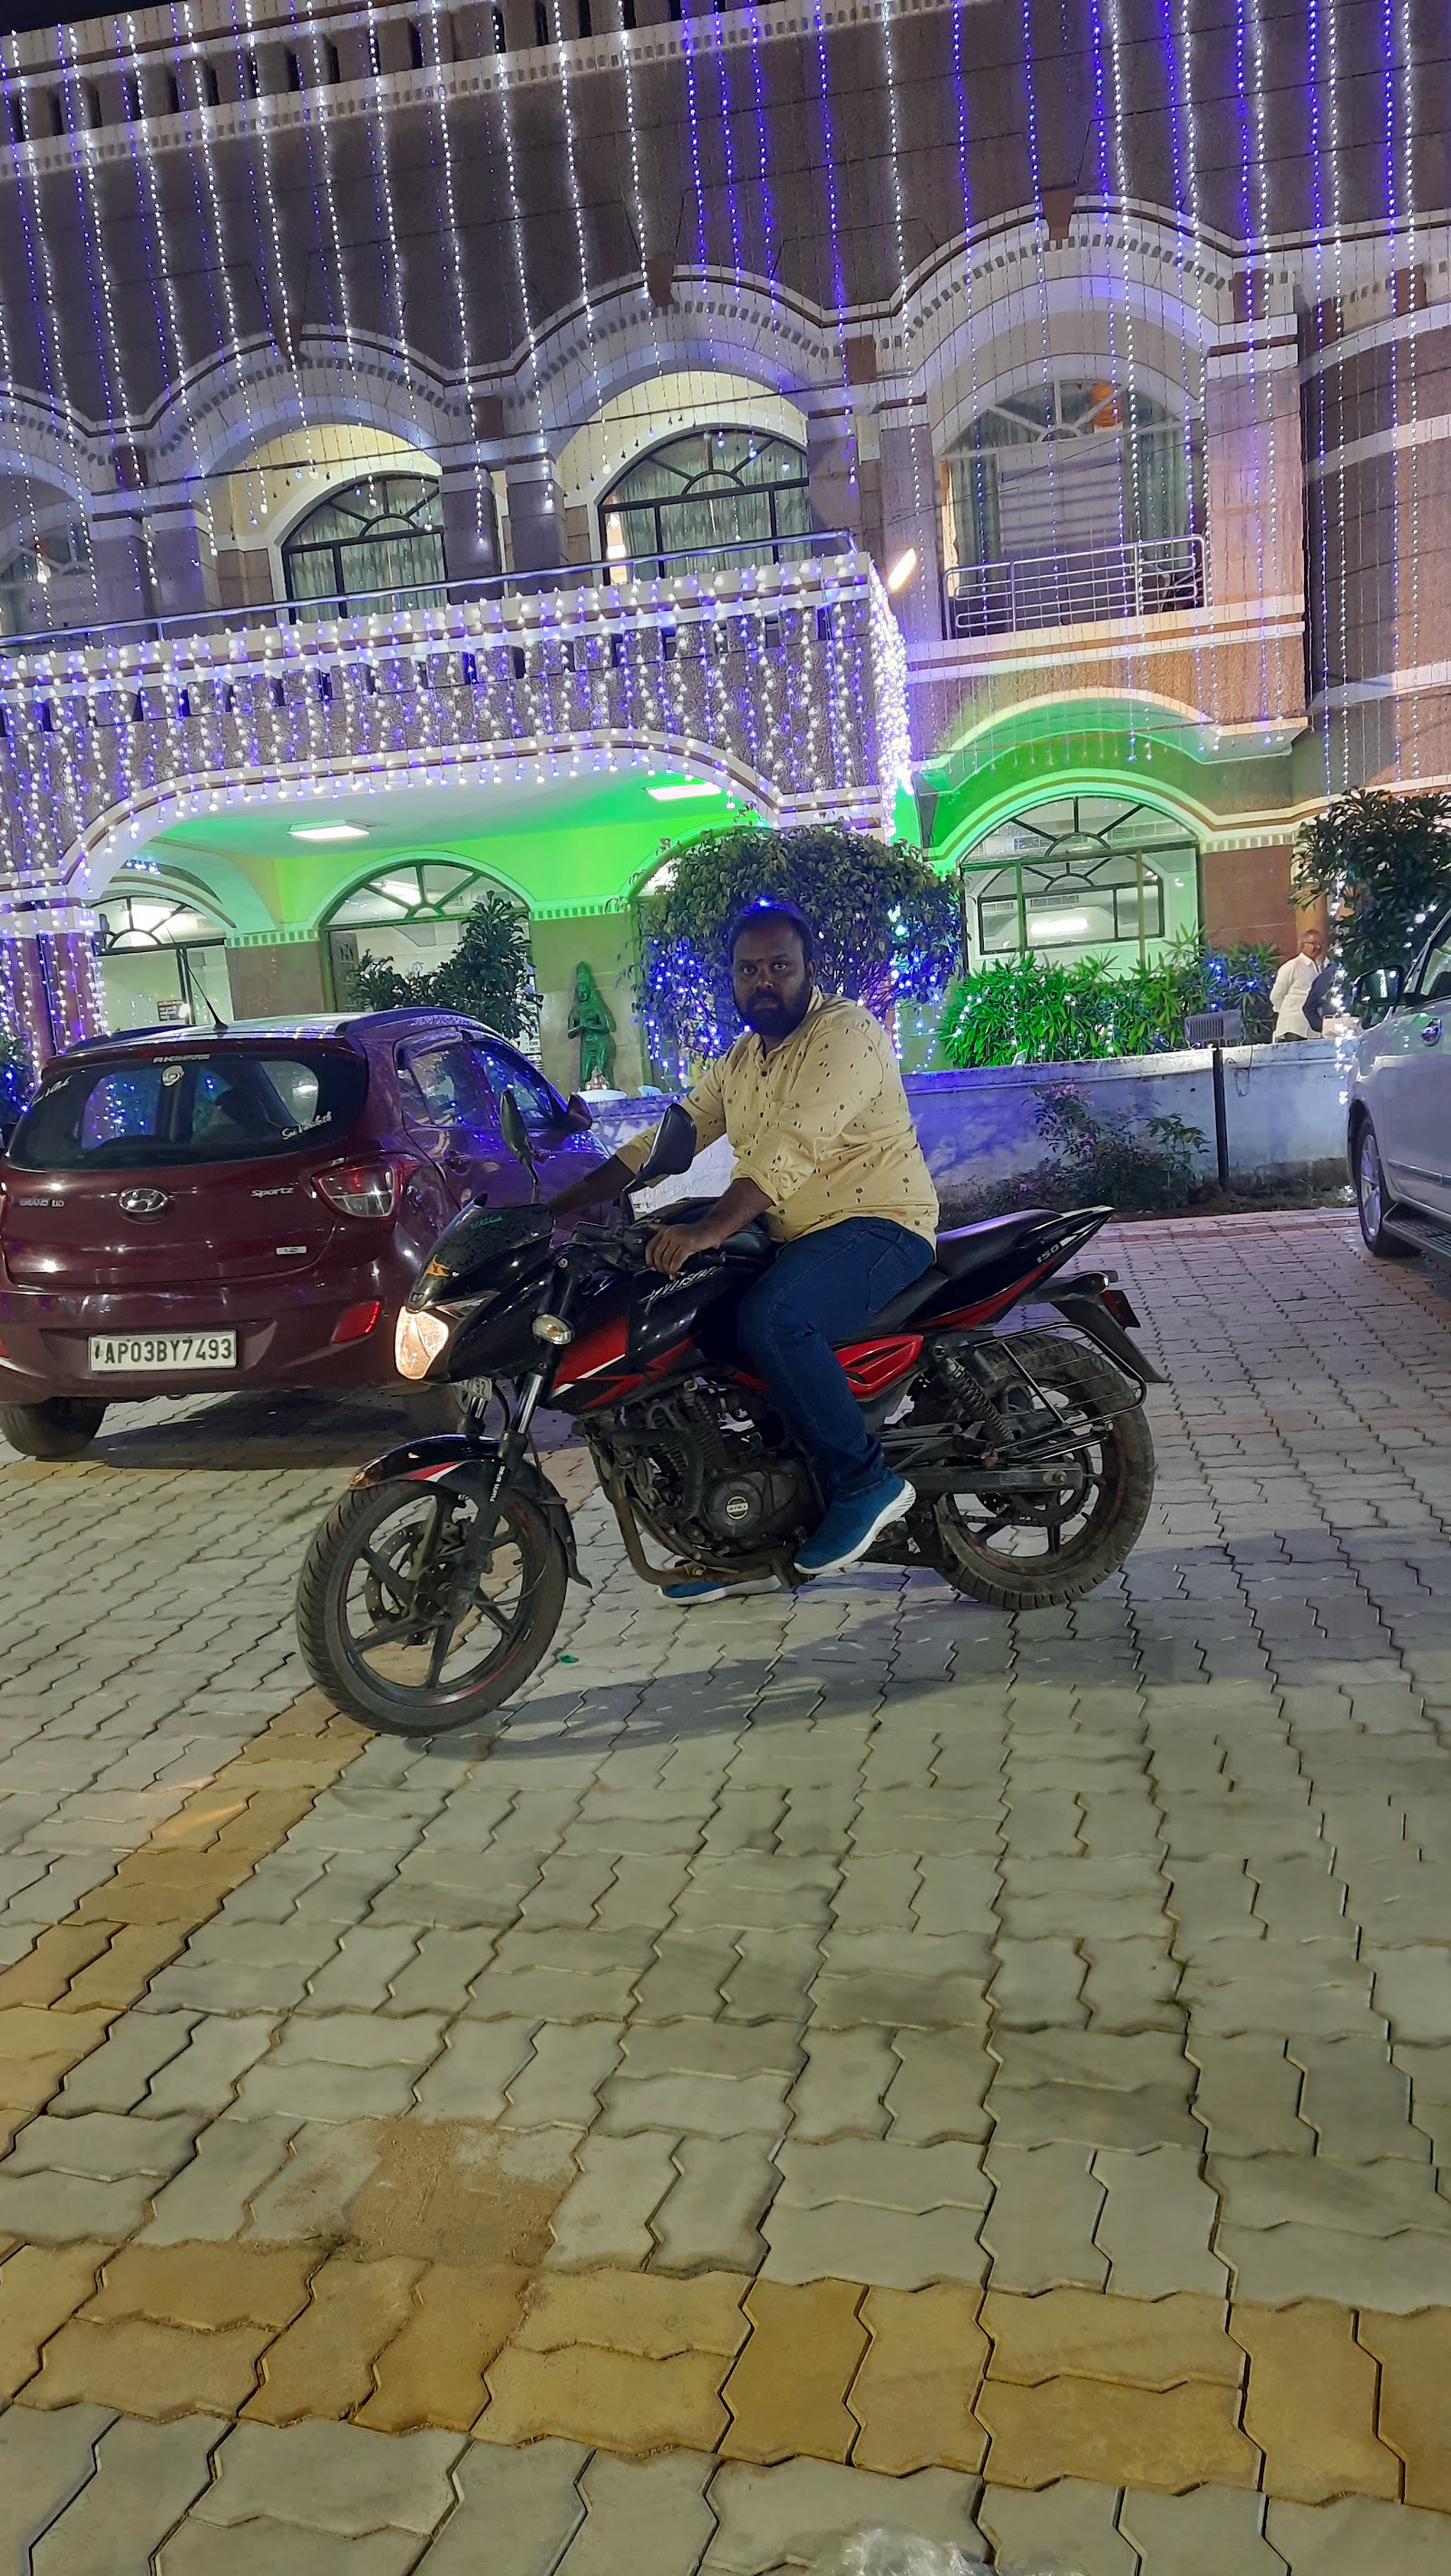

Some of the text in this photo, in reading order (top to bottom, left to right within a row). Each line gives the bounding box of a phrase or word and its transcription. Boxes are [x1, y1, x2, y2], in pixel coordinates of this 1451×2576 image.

[250, 1187, 294, 1198] Sportz
[1036, 1243, 1060, 1264] 150
[104, 1337, 232, 1364] AP03BY7493
